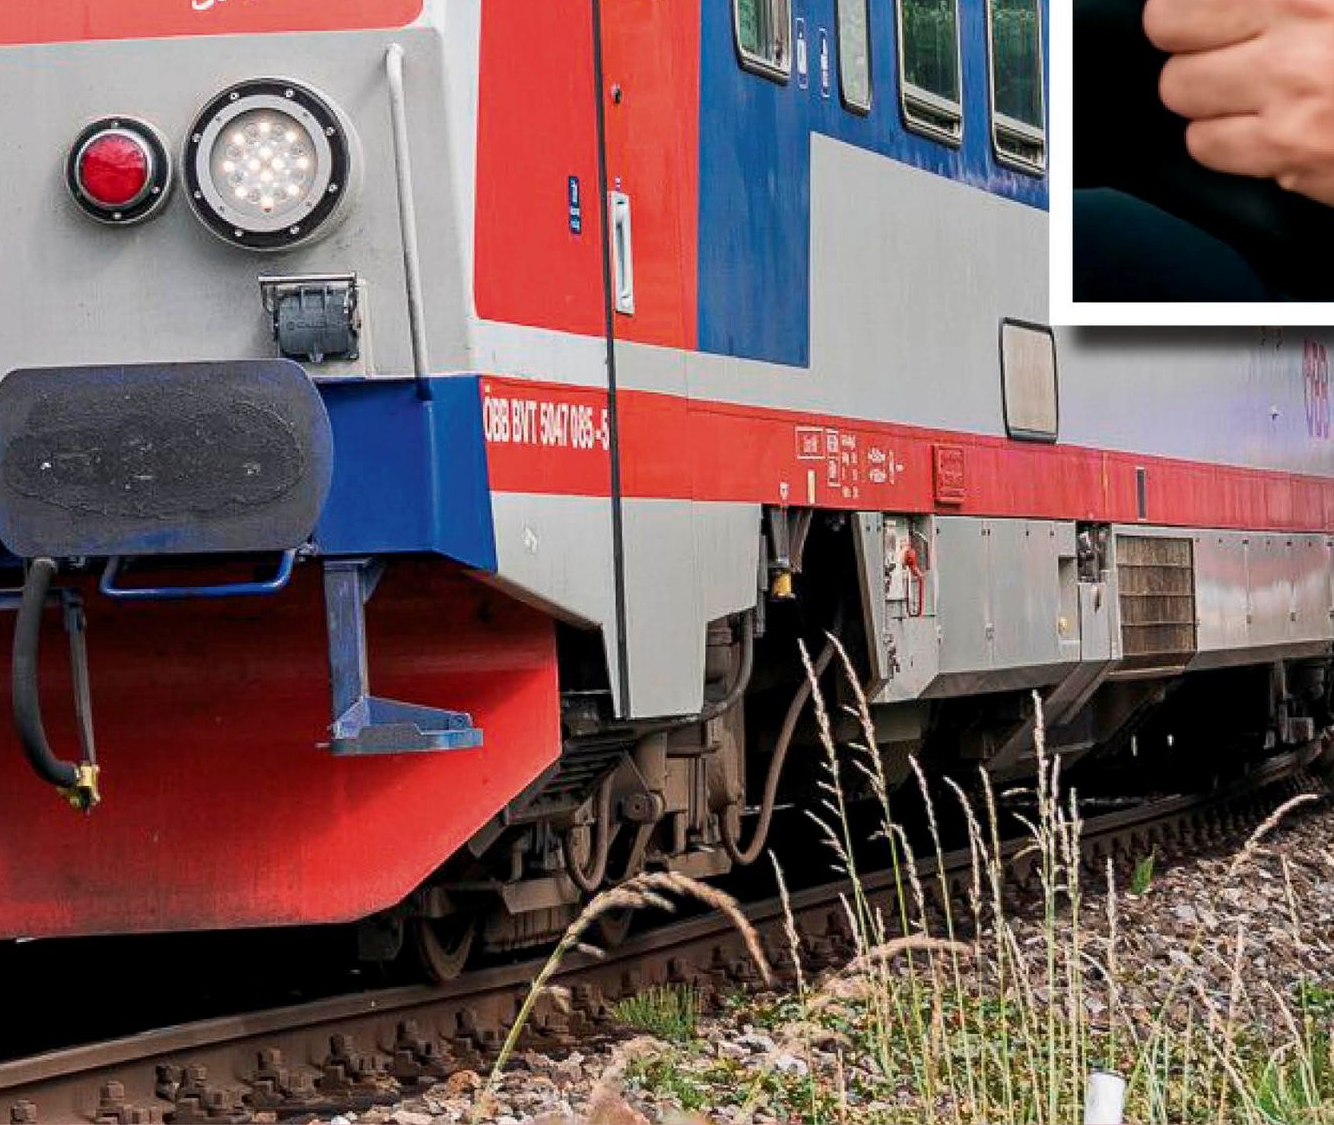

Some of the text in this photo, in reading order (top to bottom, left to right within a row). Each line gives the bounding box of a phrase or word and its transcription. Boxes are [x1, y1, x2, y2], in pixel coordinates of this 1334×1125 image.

[483, 384, 509, 443] ÖBB
[511, 398, 537, 445] BVT
[539, 401, 568, 447] 5047
